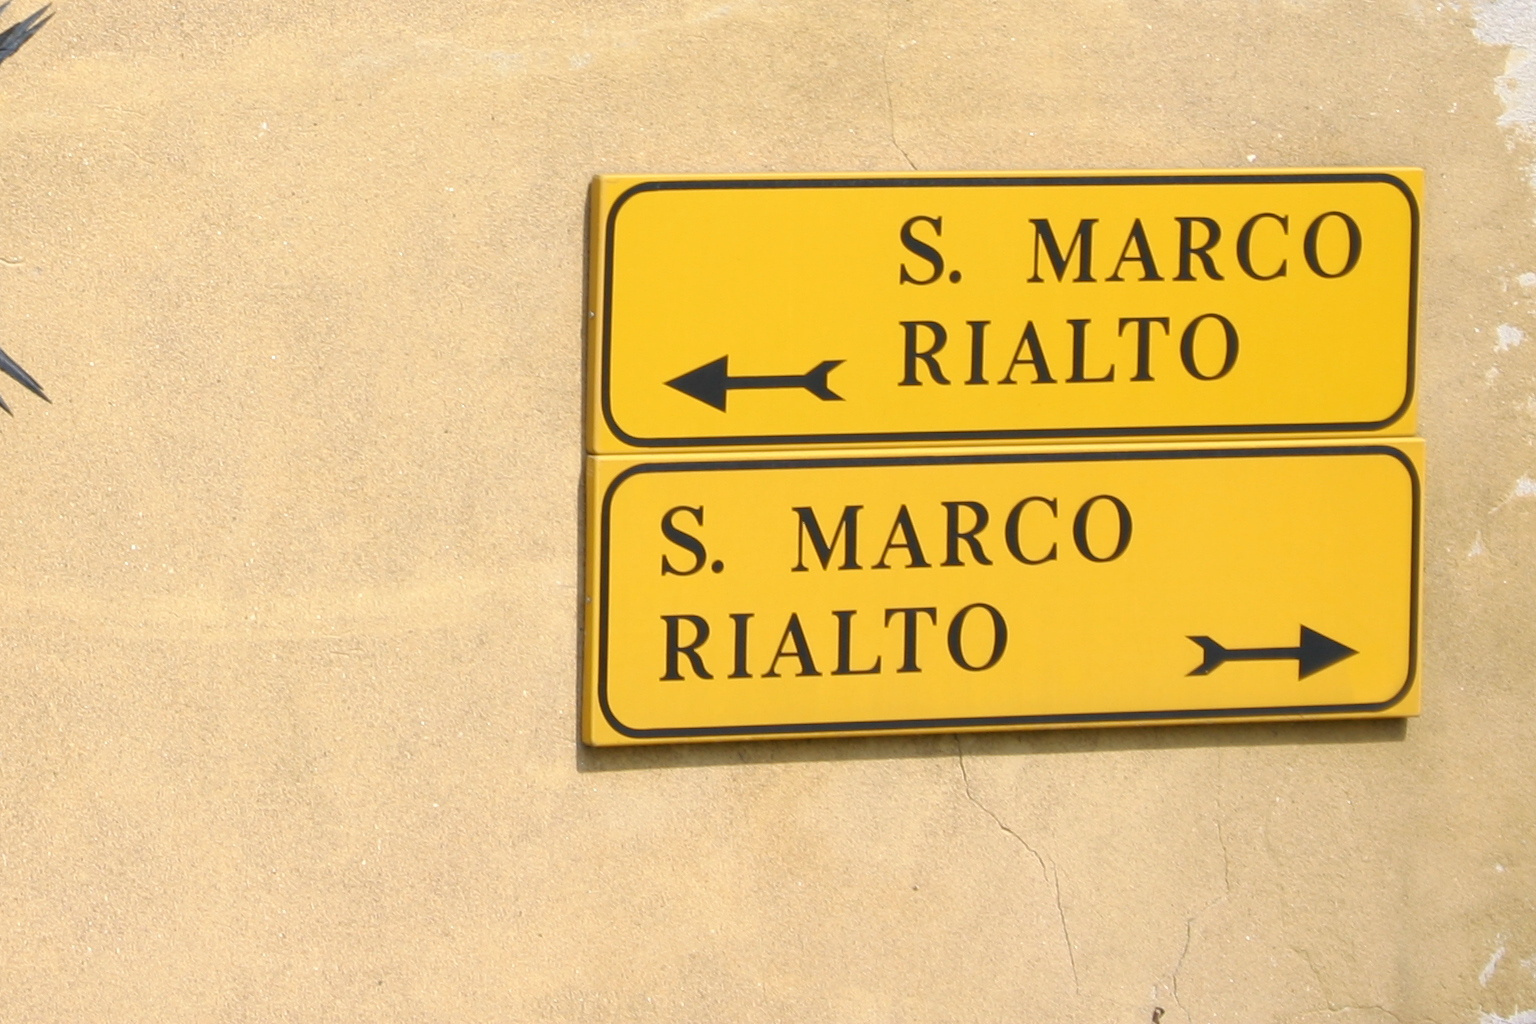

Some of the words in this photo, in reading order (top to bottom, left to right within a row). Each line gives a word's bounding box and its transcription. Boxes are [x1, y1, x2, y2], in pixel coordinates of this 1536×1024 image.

[899, 216, 963, 285] S.
[1028, 211, 1363, 283] MARCO
[898, 313, 1240, 387] RIALTO
[660, 506, 726, 576] S.
[792, 494, 1134, 572] MARCO
[660, 603, 1008, 682] RIALTO
